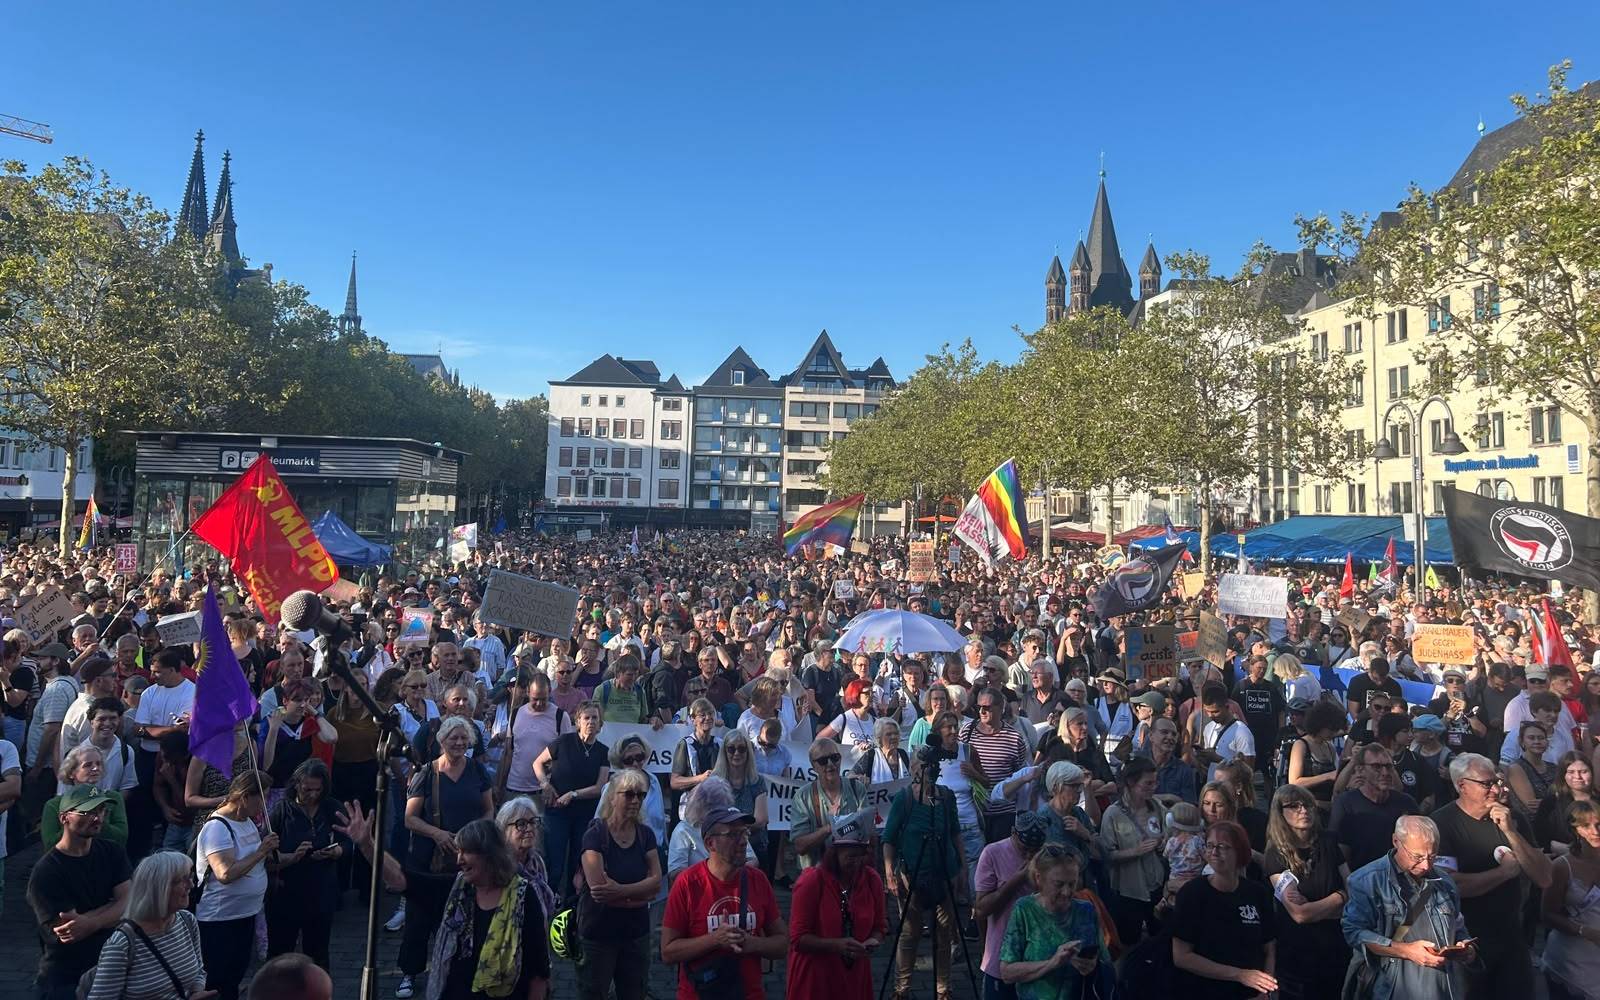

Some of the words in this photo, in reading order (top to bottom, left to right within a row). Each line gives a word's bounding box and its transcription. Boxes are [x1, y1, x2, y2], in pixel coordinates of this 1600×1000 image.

[270, 506, 337, 582] MLPD
[117, 558, 136, 569] NZS
[31, 614, 65, 641] Dumme
[1432, 638, 1457, 647] GEGEN
[1418, 648, 1465, 660] JUDENHASS
